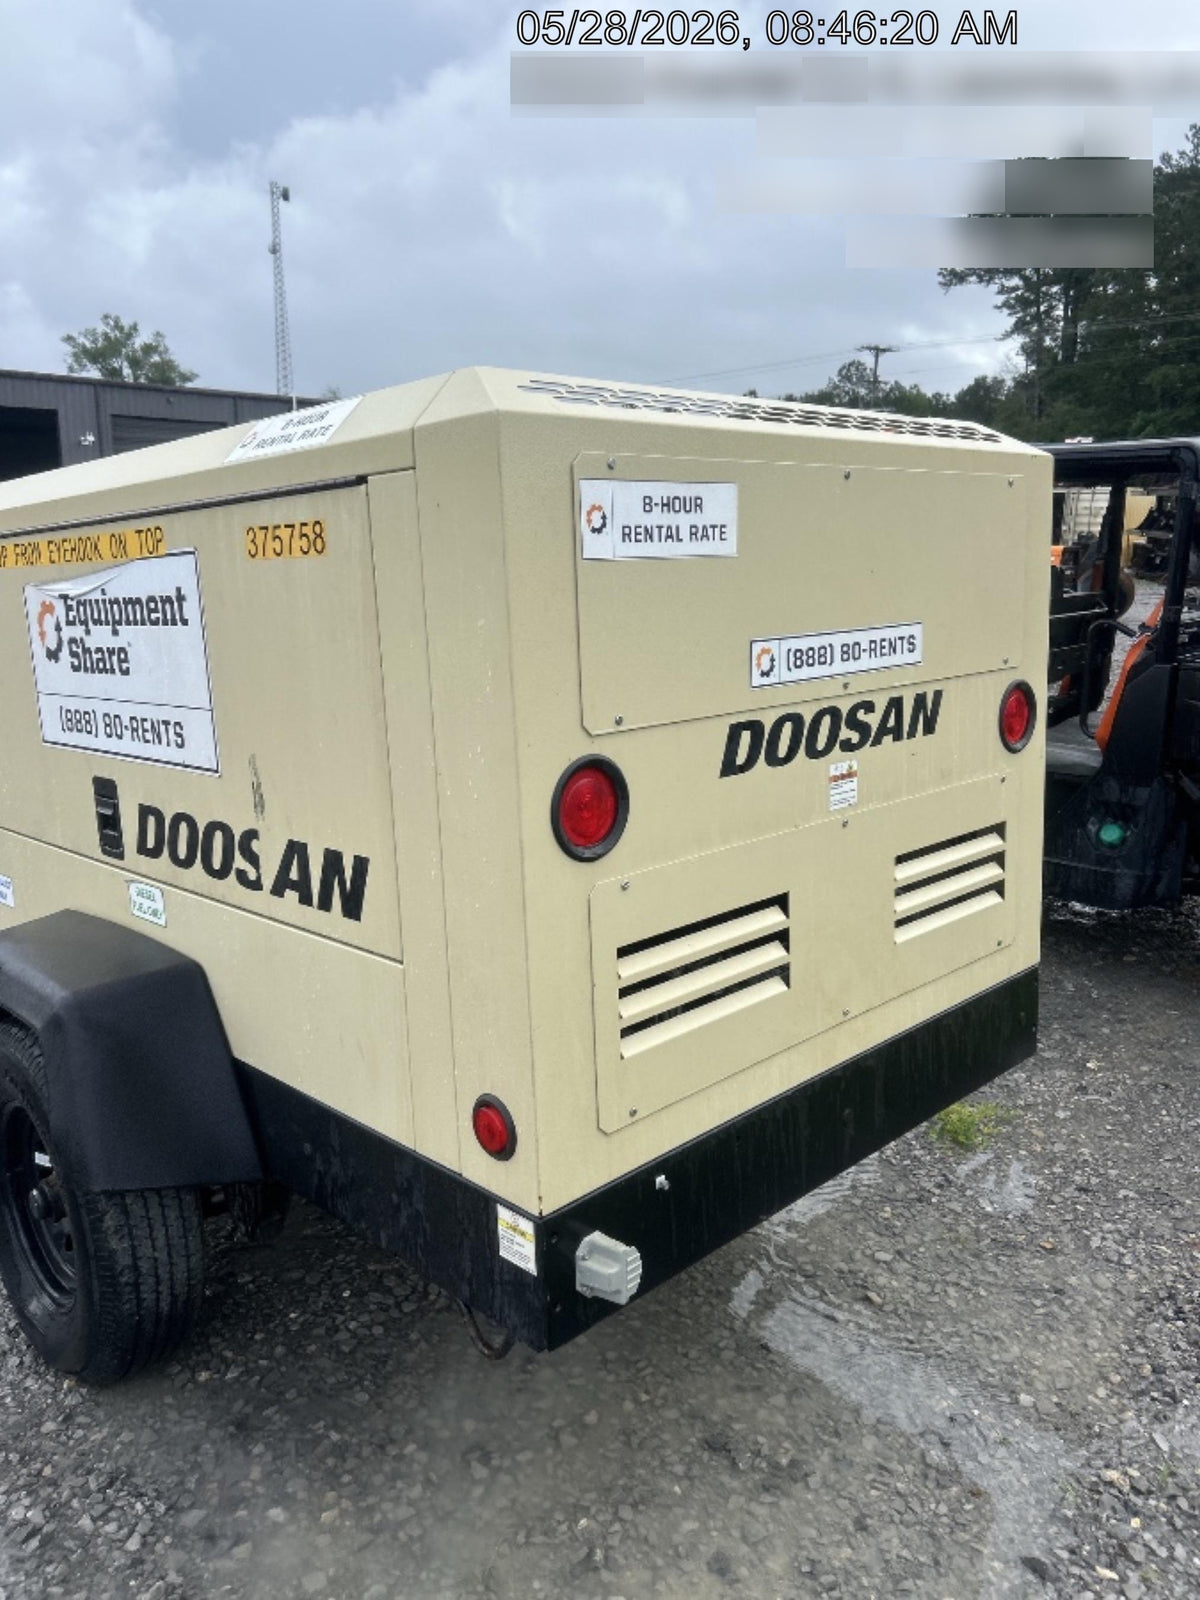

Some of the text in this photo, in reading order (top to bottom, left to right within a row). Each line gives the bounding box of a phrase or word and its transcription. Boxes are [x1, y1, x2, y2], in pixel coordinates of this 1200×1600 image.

[13, 540, 42, 567] FROM
[47, 535, 103, 565] EYEHOOK
[109, 532, 129, 559] ON
[134, 525, 165, 556] TOP
[246, 519, 327, 559] 375758
[621, 524, 728, 544] RENTAL RATE
[58, 586, 190, 637] Equipment
[66, 636, 131, 676] Share
[786, 634, 917, 672] (888) 80-RENTS
[59, 705, 186, 749] (888) 80-RENTS
[719, 689, 944, 779] DOOSAN
[136, 802, 371, 923] DOOSAN
